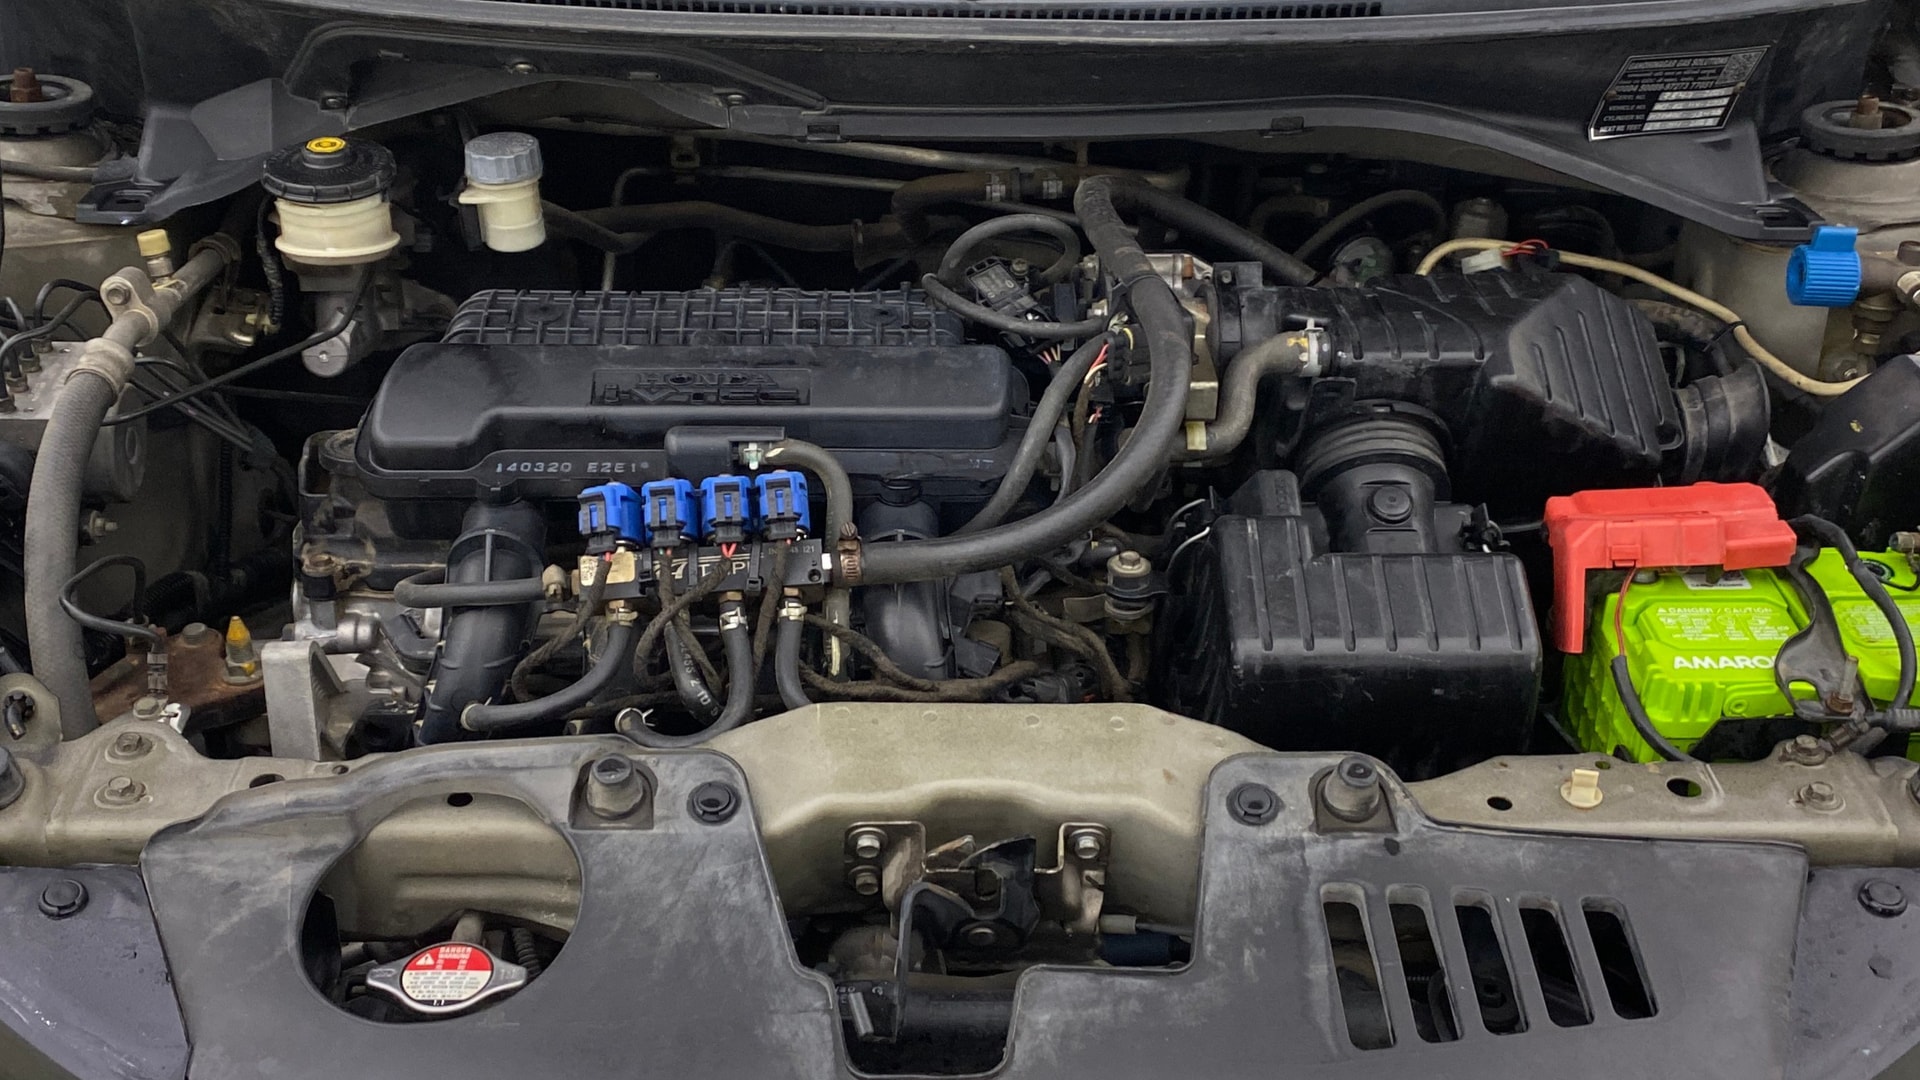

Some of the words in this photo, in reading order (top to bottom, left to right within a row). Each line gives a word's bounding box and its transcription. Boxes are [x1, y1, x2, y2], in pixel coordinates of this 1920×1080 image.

[638, 370, 779, 388] HONDA
[496, 462, 572, 473] 140320
[1674, 655, 1778, 669] AMARO
[440, 946, 473, 954] DANGER
